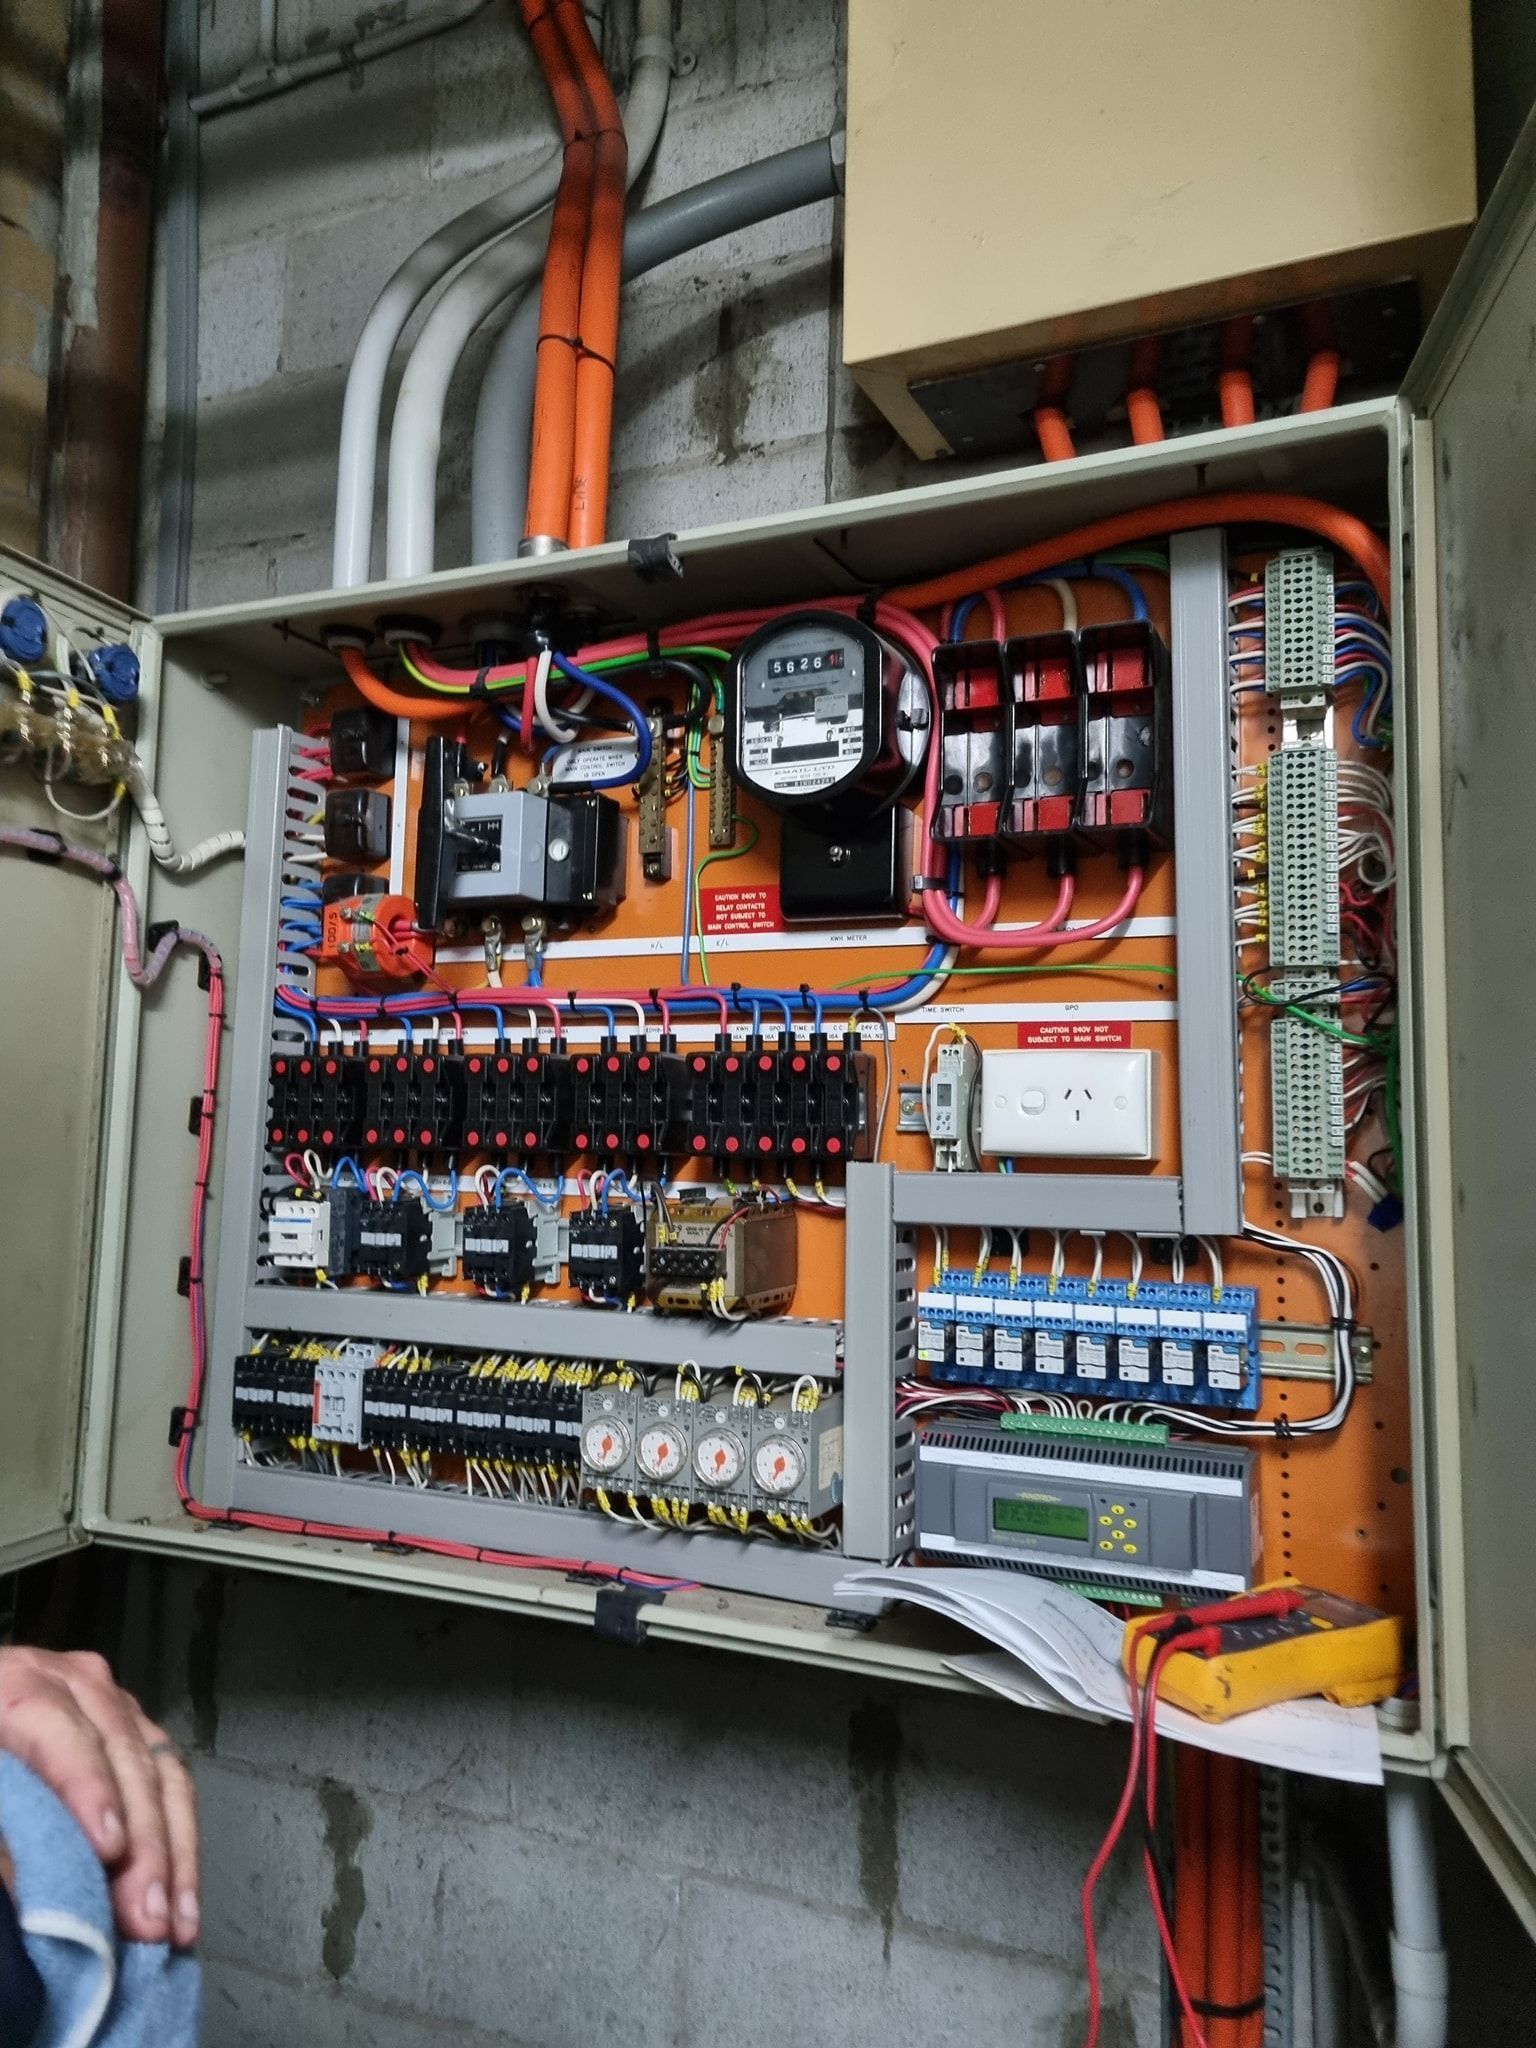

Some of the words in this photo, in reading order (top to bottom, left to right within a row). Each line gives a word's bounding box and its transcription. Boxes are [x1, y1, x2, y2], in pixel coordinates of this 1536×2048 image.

[715, 893, 738, 901] CAUTION
[730, 912, 756, 920] SUBJECT
[724, 922, 750, 930] CONTROL
[1040, 1026, 1069, 1034] CAUTION
[1027, 1036, 1059, 1044] SUBJECT
[1074, 1035, 1091, 1043] MAIN
